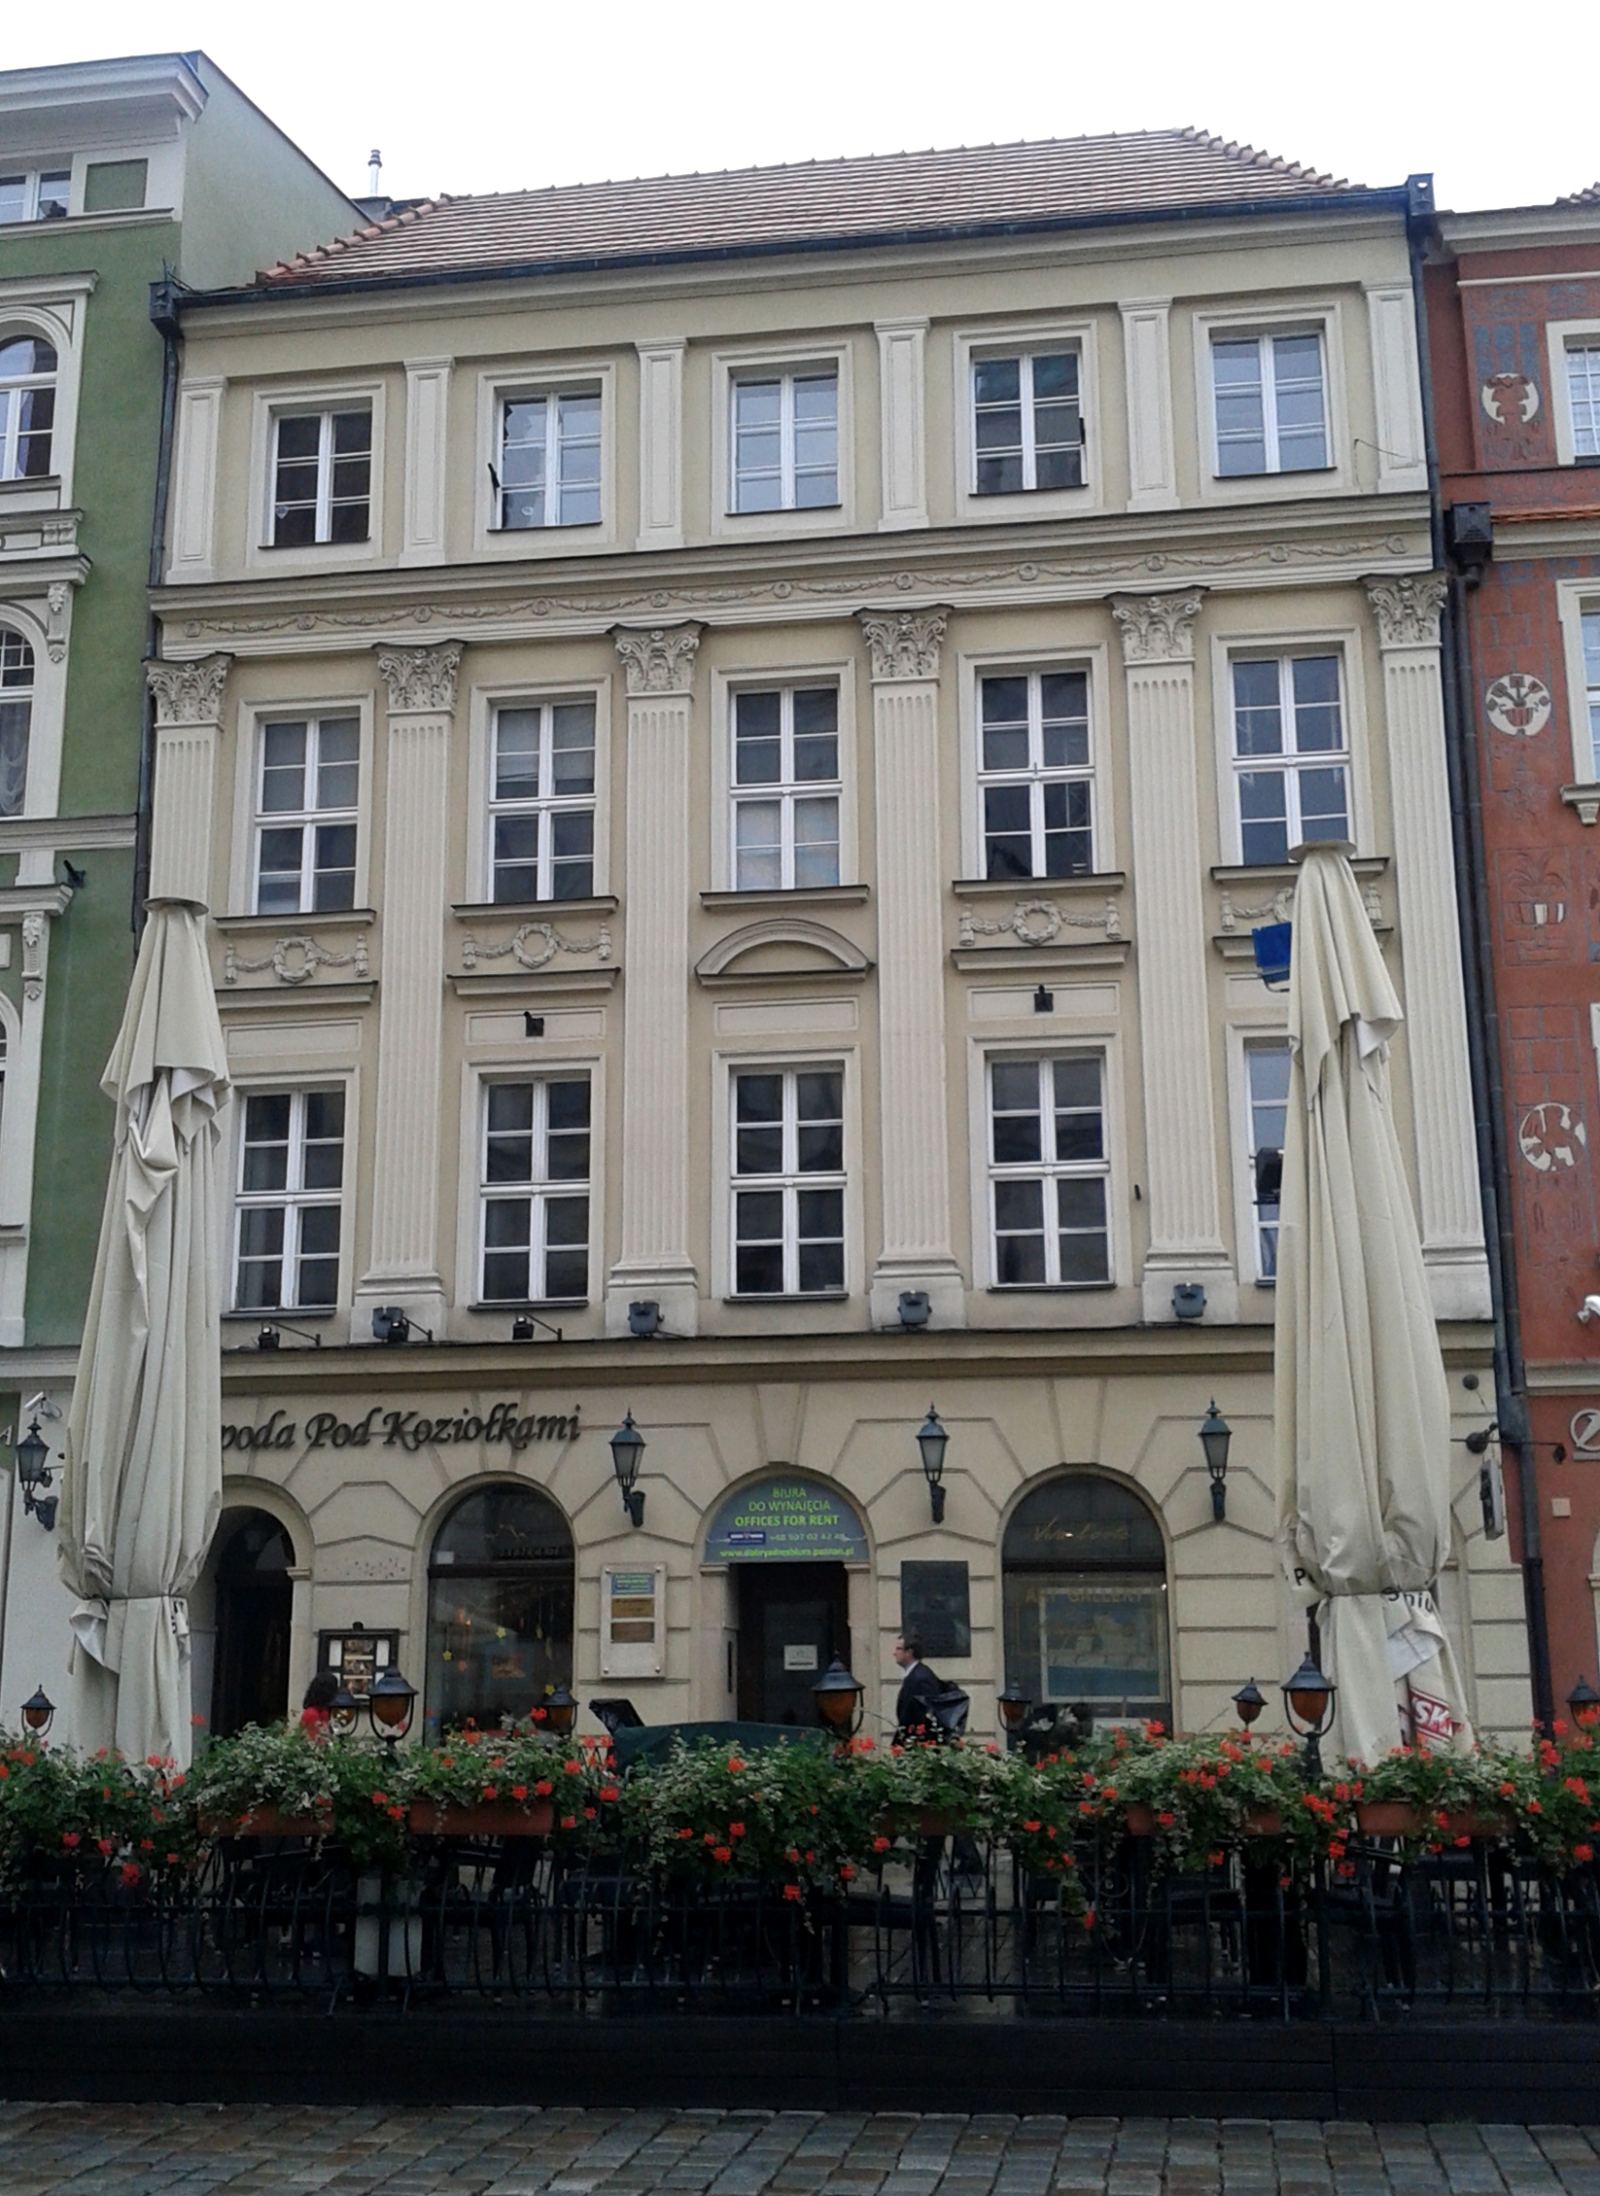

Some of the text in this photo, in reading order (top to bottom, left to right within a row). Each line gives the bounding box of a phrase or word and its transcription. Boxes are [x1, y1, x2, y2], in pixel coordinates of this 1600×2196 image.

[222, 1402, 582, 1452] poda Pod Koziołkami
[772, 1487, 807, 1498] BIURA
[748, 1499, 831, 1513] DO WYNAJĘCIA
[735, 1514, 840, 1527] OFFICES FOR RENT
